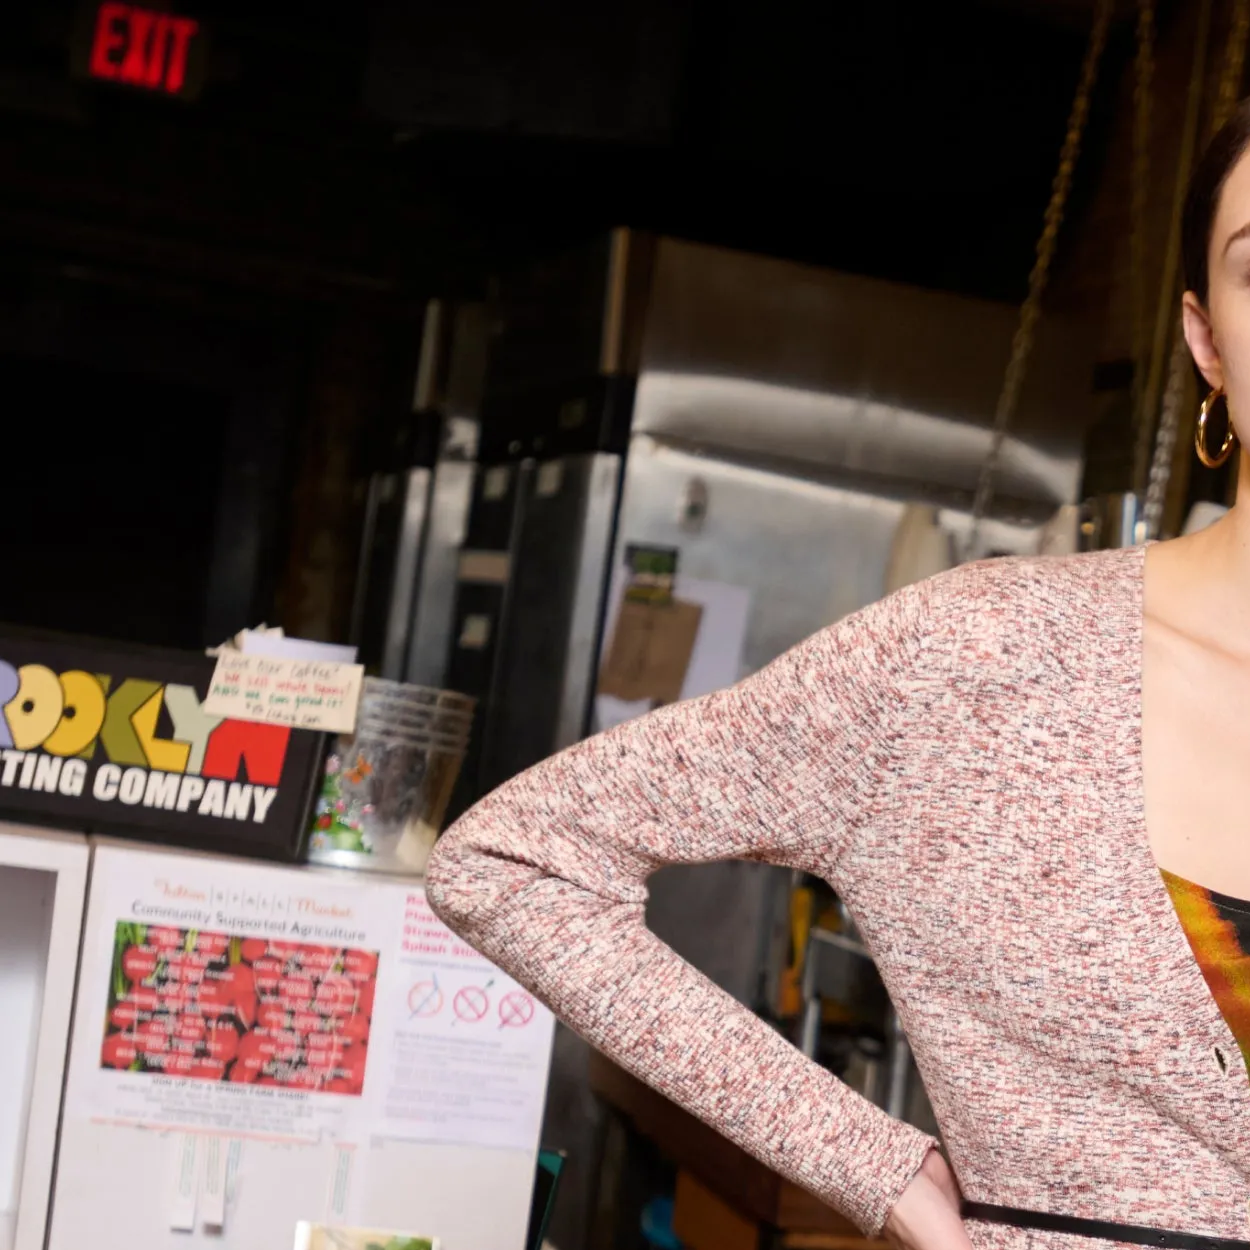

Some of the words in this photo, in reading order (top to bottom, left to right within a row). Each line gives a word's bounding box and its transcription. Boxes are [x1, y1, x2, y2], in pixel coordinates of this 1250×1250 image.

[90, 2, 198, 95] EXIT
[93, 763, 278, 824] COMPANY
[132, 899, 211, 924] Community
[216, 910, 286, 933] Supported
[290, 921, 367, 942] Agriculture
[405, 909, 440, 923] Plast
